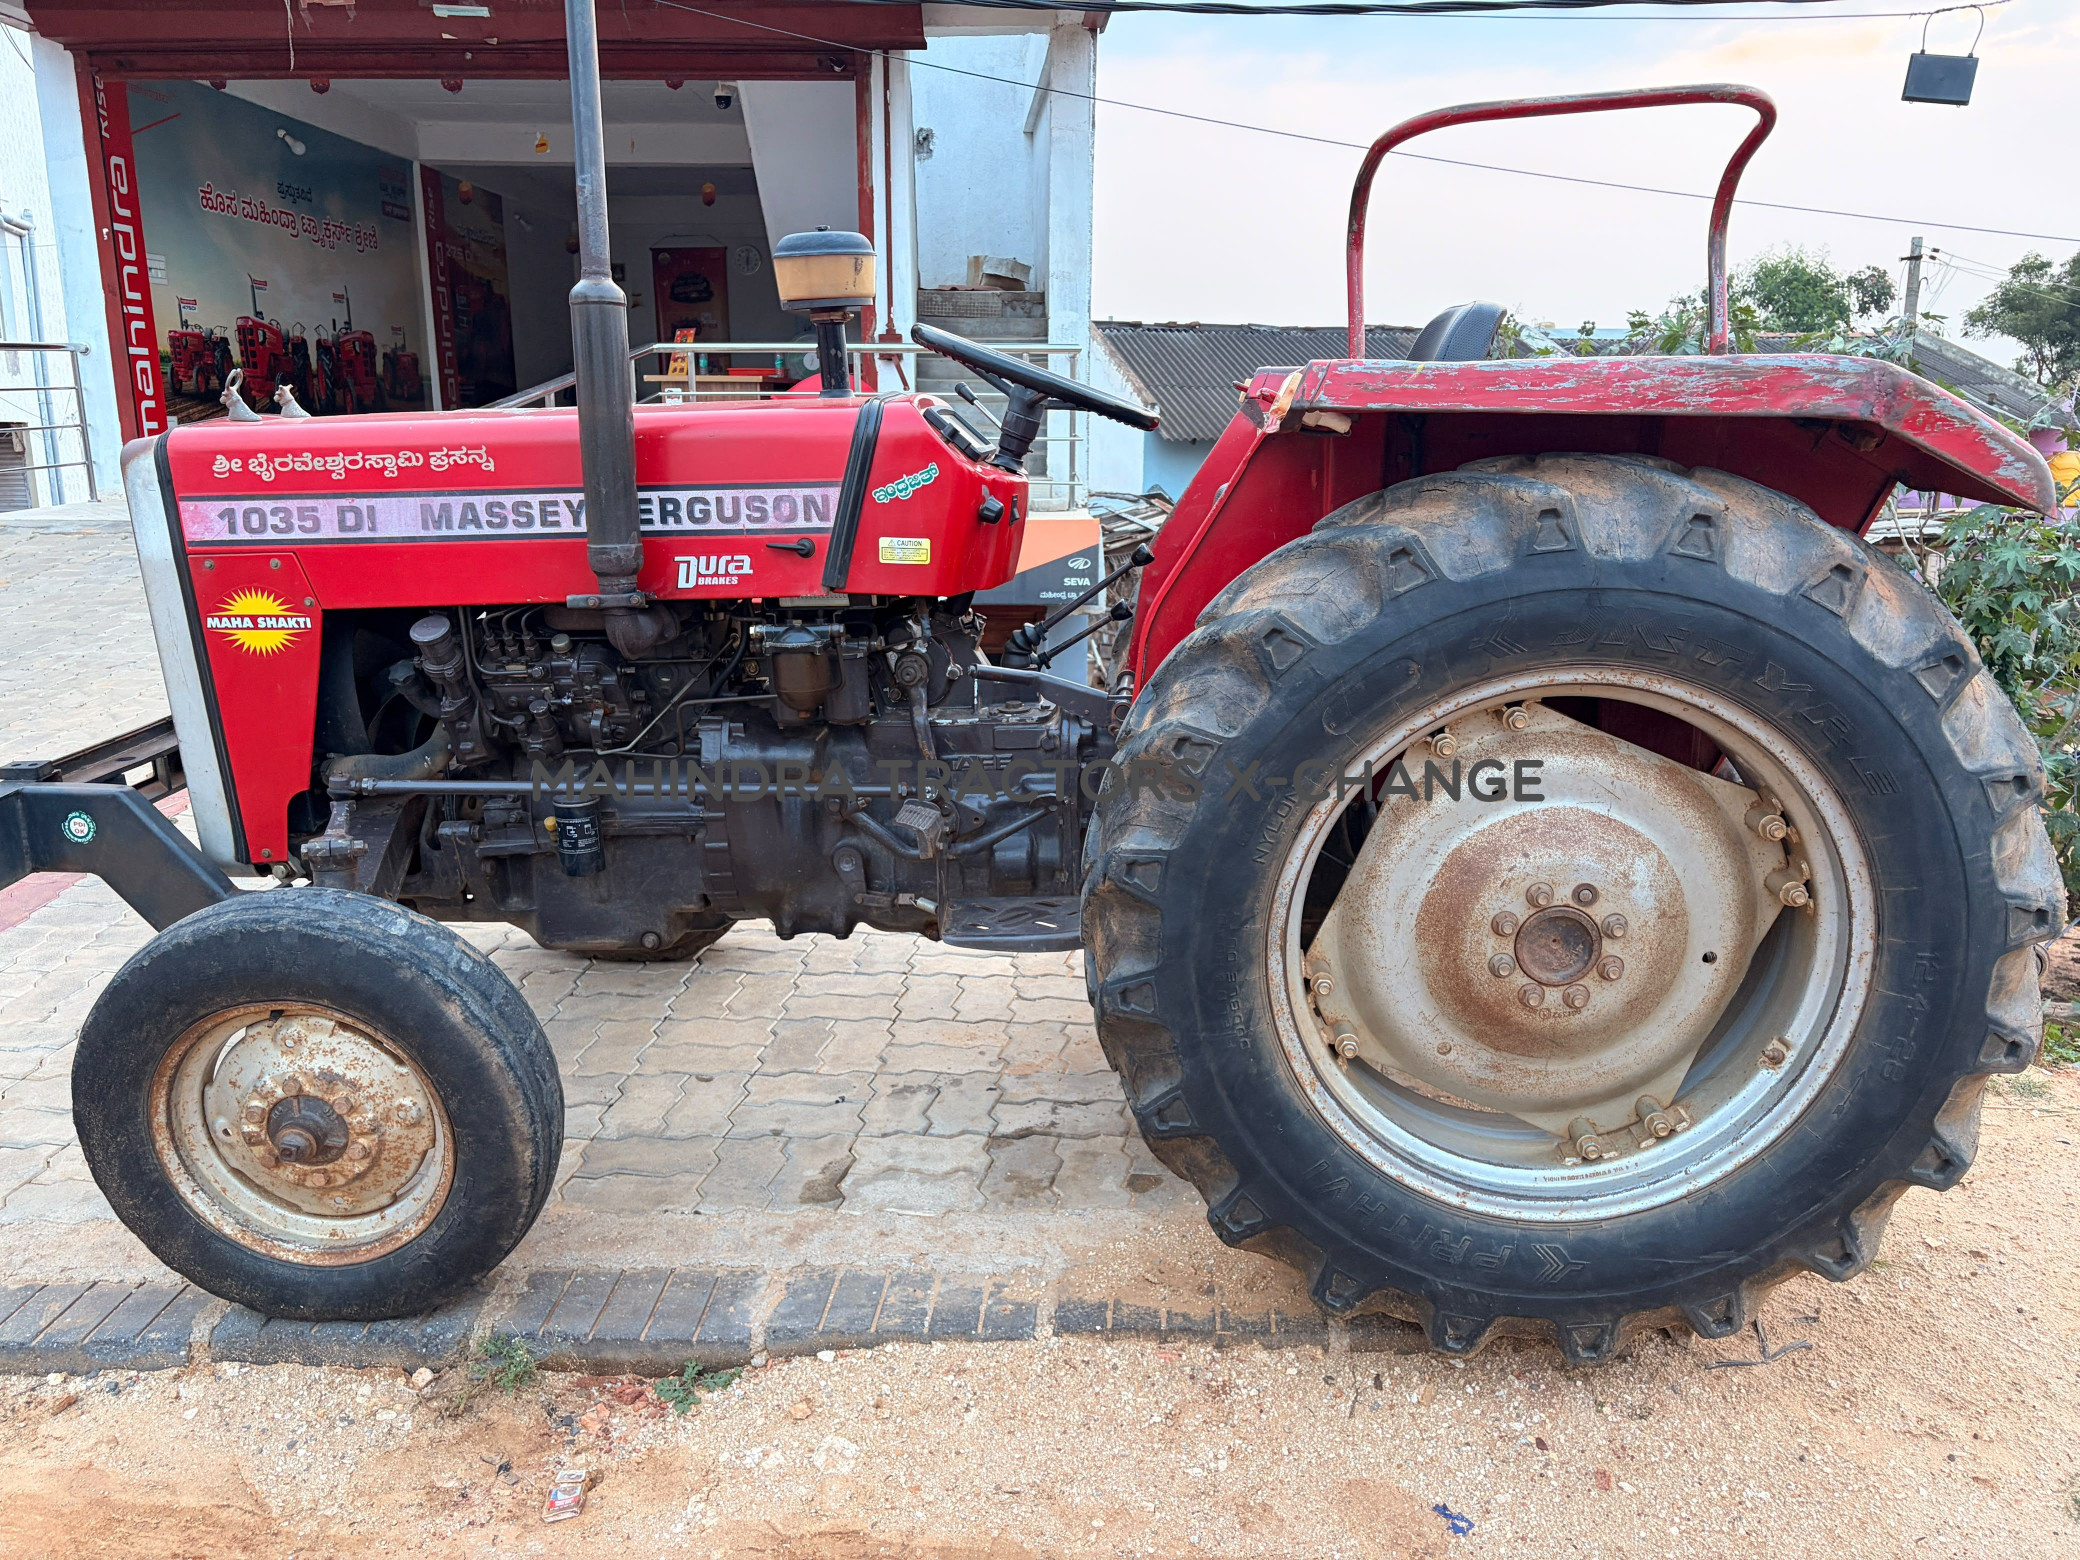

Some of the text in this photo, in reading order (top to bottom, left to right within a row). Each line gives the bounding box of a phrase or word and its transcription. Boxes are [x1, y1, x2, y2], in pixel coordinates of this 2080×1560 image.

[212, 453, 243, 479] ಶ್ರೀ
[429, 445, 496, 472] ಪ್ರಸನ್ನ
[217, 494, 831, 535] 1035 DI MASSEY ERGUSON
[896, 539, 923, 547] CAUTION
[697, 576, 739, 586] BRAKES
[1063, 577, 1091, 586] SEVA
[206, 616, 312, 629] MAHA SHAKTI
